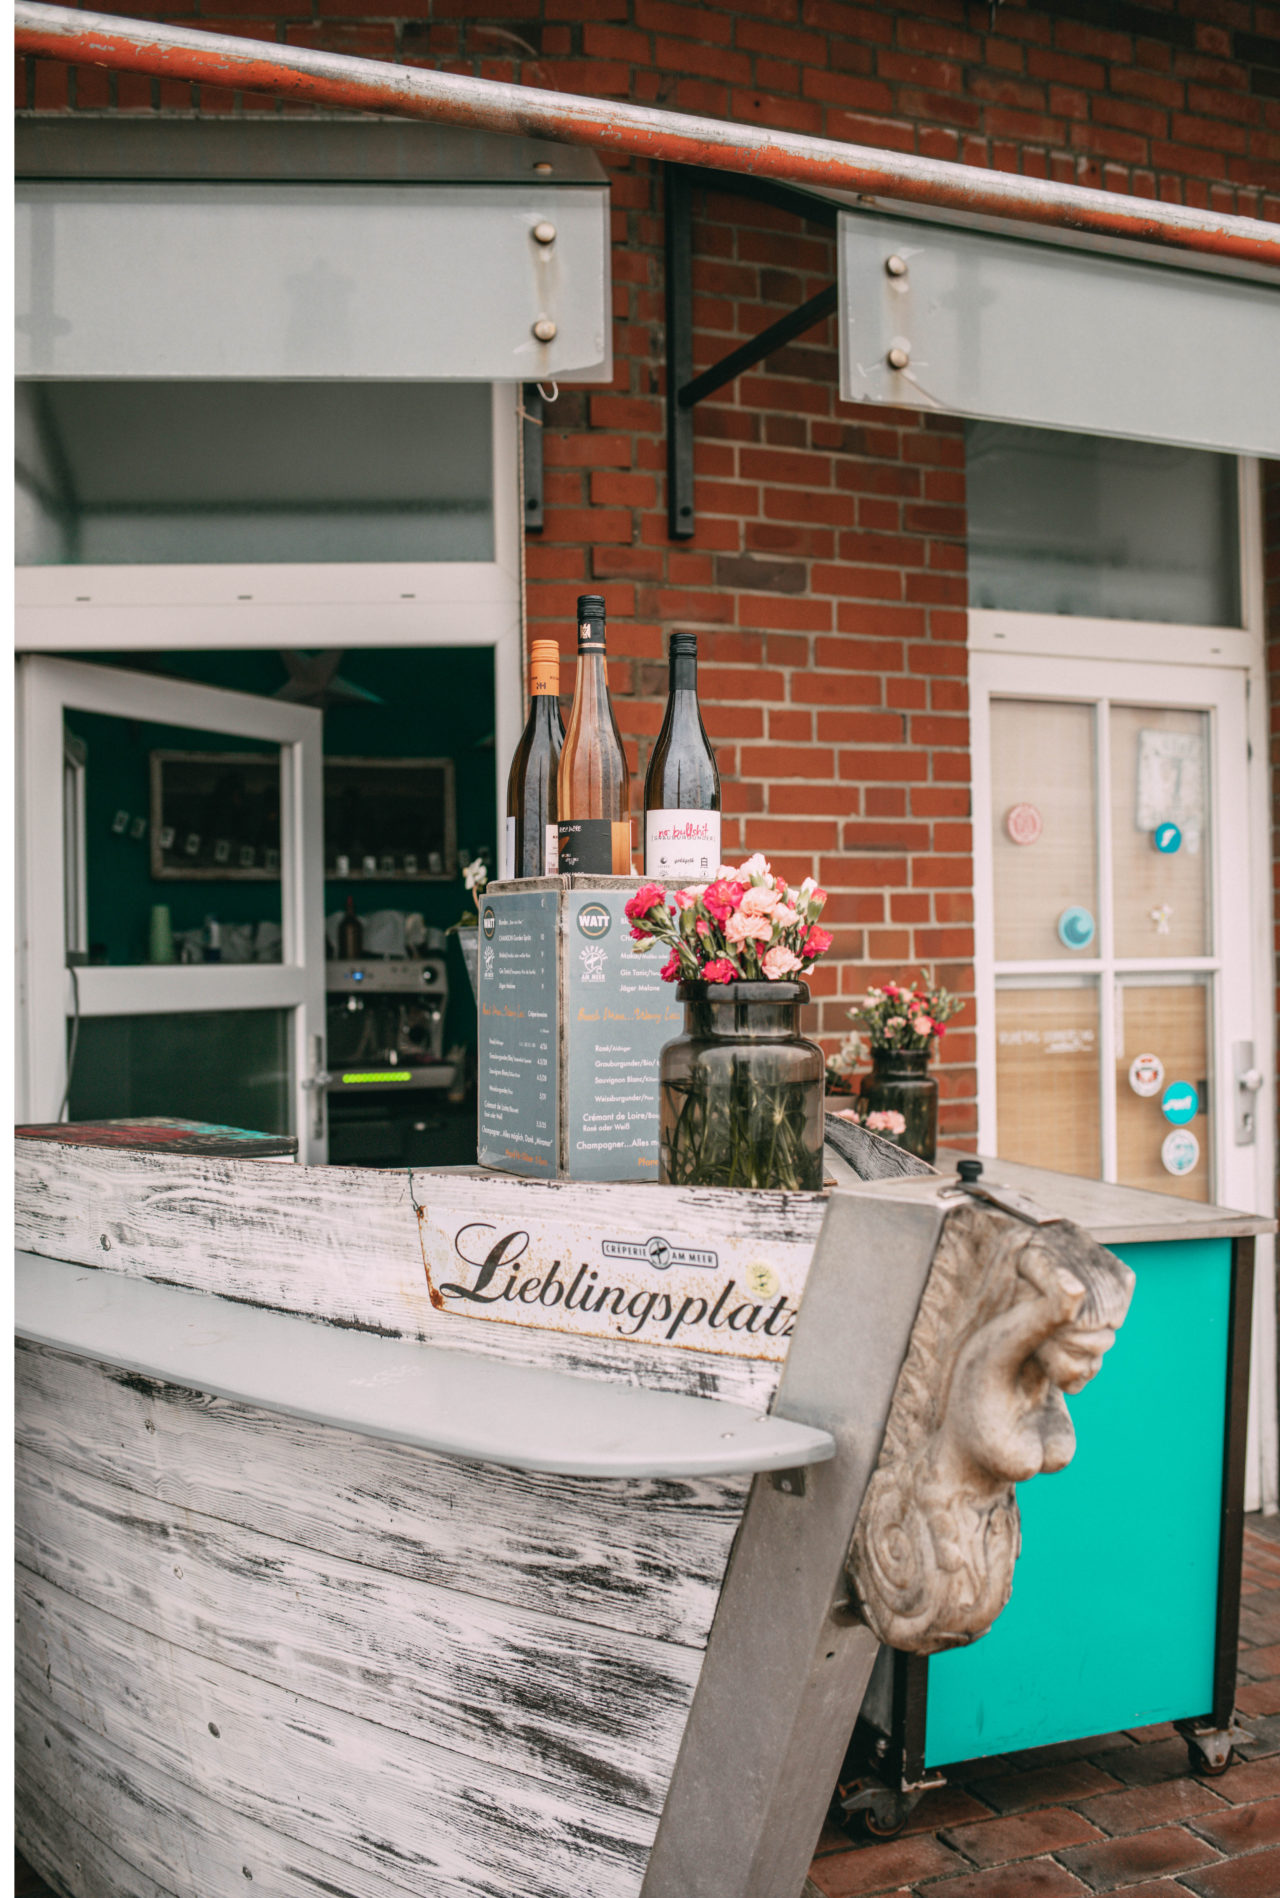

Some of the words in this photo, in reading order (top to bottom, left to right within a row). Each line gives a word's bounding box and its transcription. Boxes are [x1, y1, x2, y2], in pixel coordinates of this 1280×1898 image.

[672, 821, 708, 838] bullshit
[578, 915, 610, 928] WATT
[583, 1112, 614, 1122] Crémant
[615, 1111, 626, 1121] de
[582, 1124, 597, 1132] Rosé
[598, 1124, 613, 1132] oder
[614, 1122, 631, 1131] Weiß
[672, 1252, 686, 1261] AM
[689, 1253, 713, 1264] MEER
